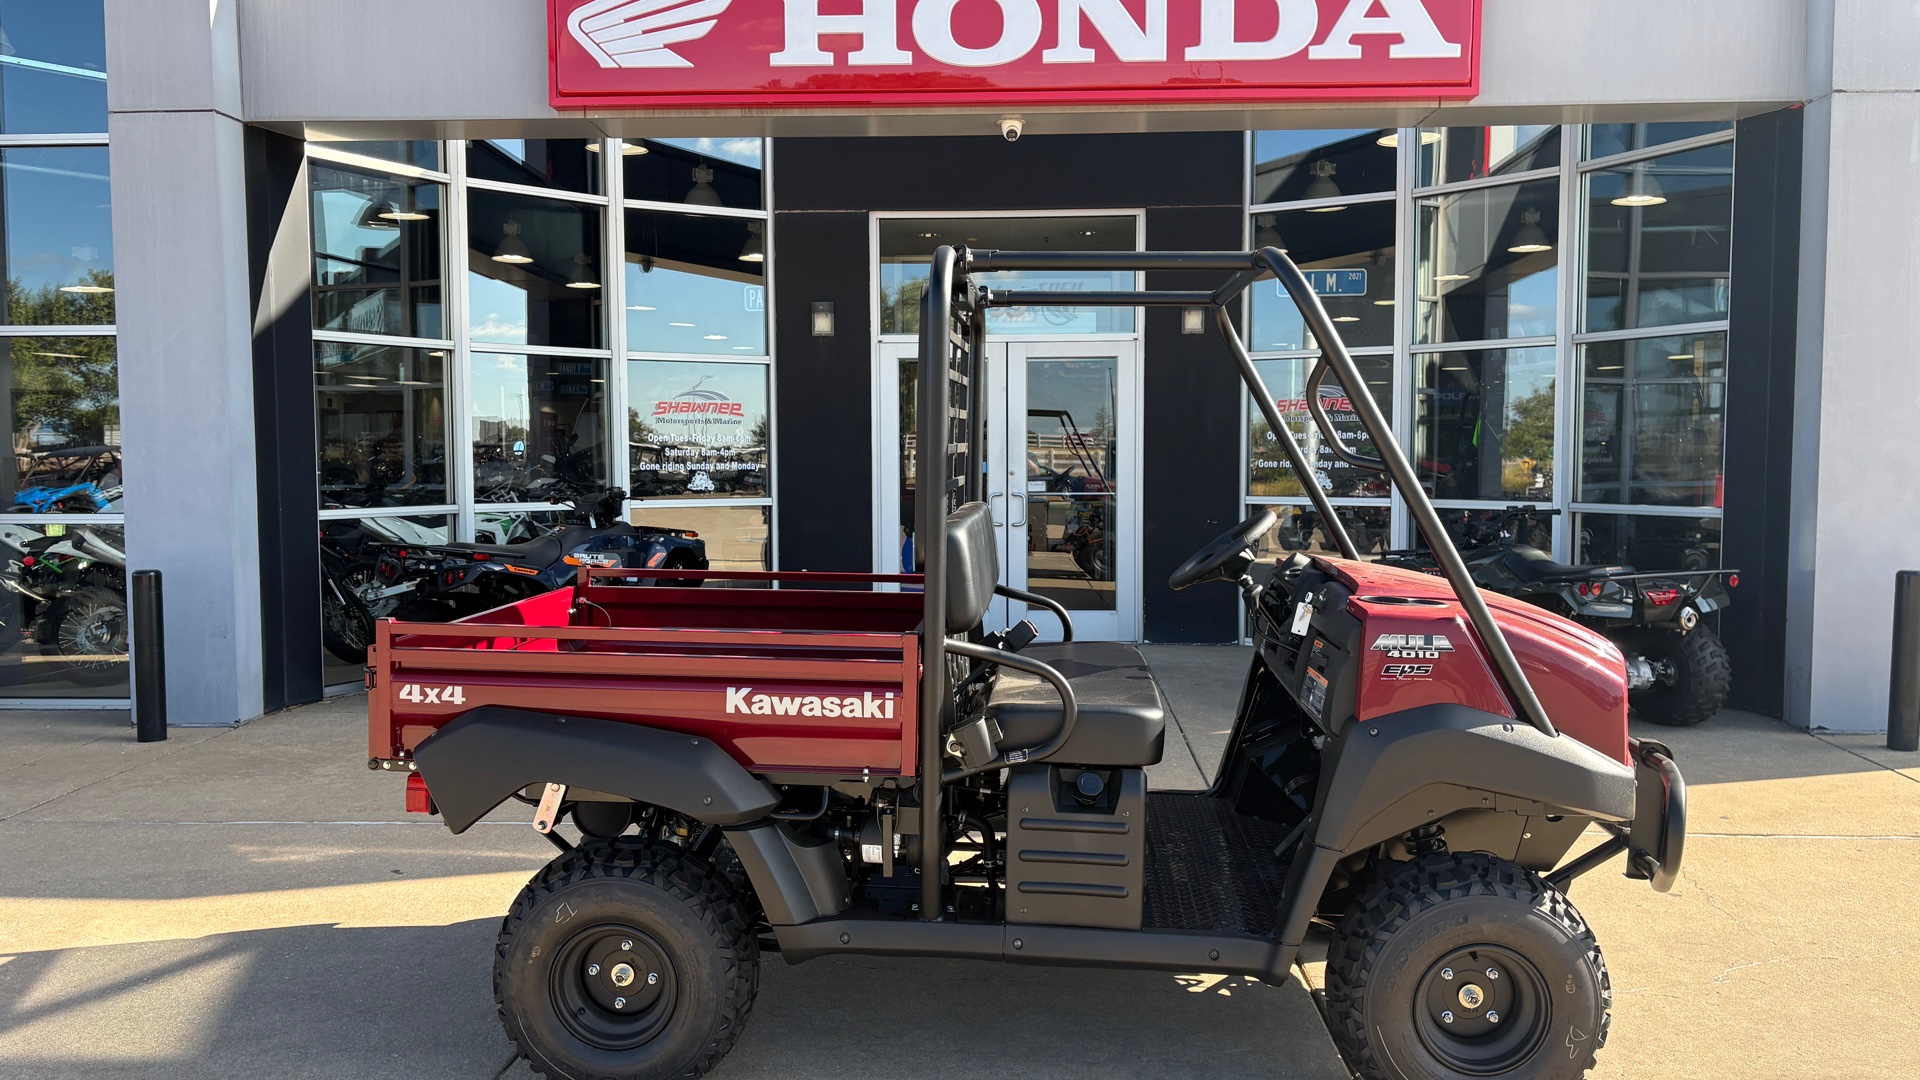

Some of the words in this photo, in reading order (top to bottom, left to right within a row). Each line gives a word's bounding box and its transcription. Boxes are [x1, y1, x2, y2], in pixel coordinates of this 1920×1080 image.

[770, 0, 1461, 67] HONDA
[1326, 273, 1342, 292] M.
[1348, 272, 1362, 280] 2021
[655, 417, 704, 426] Motorsports
[648, 433, 668, 443] Open
[670, 433, 716, 443] Tues-Friday
[664, 447, 699, 457] Saturday
[701, 447, 736, 457] 8am-4pm
[640, 461, 660, 470] Gone
[662, 461, 685, 471] riding
[687, 461, 714, 471] Sunday
[716, 461, 730, 470] and
[731, 461, 760, 471] Monday
[1258, 460, 1278, 468] Gone
[573, 552, 605, 560] BRUTE
[1370, 634, 1456, 652] MULE
[1386, 650, 1440, 659] 4010
[1381, 664, 1434, 679] EPS
[399, 684, 466, 704] 4x4
[726, 687, 894, 719] Kawasaki
